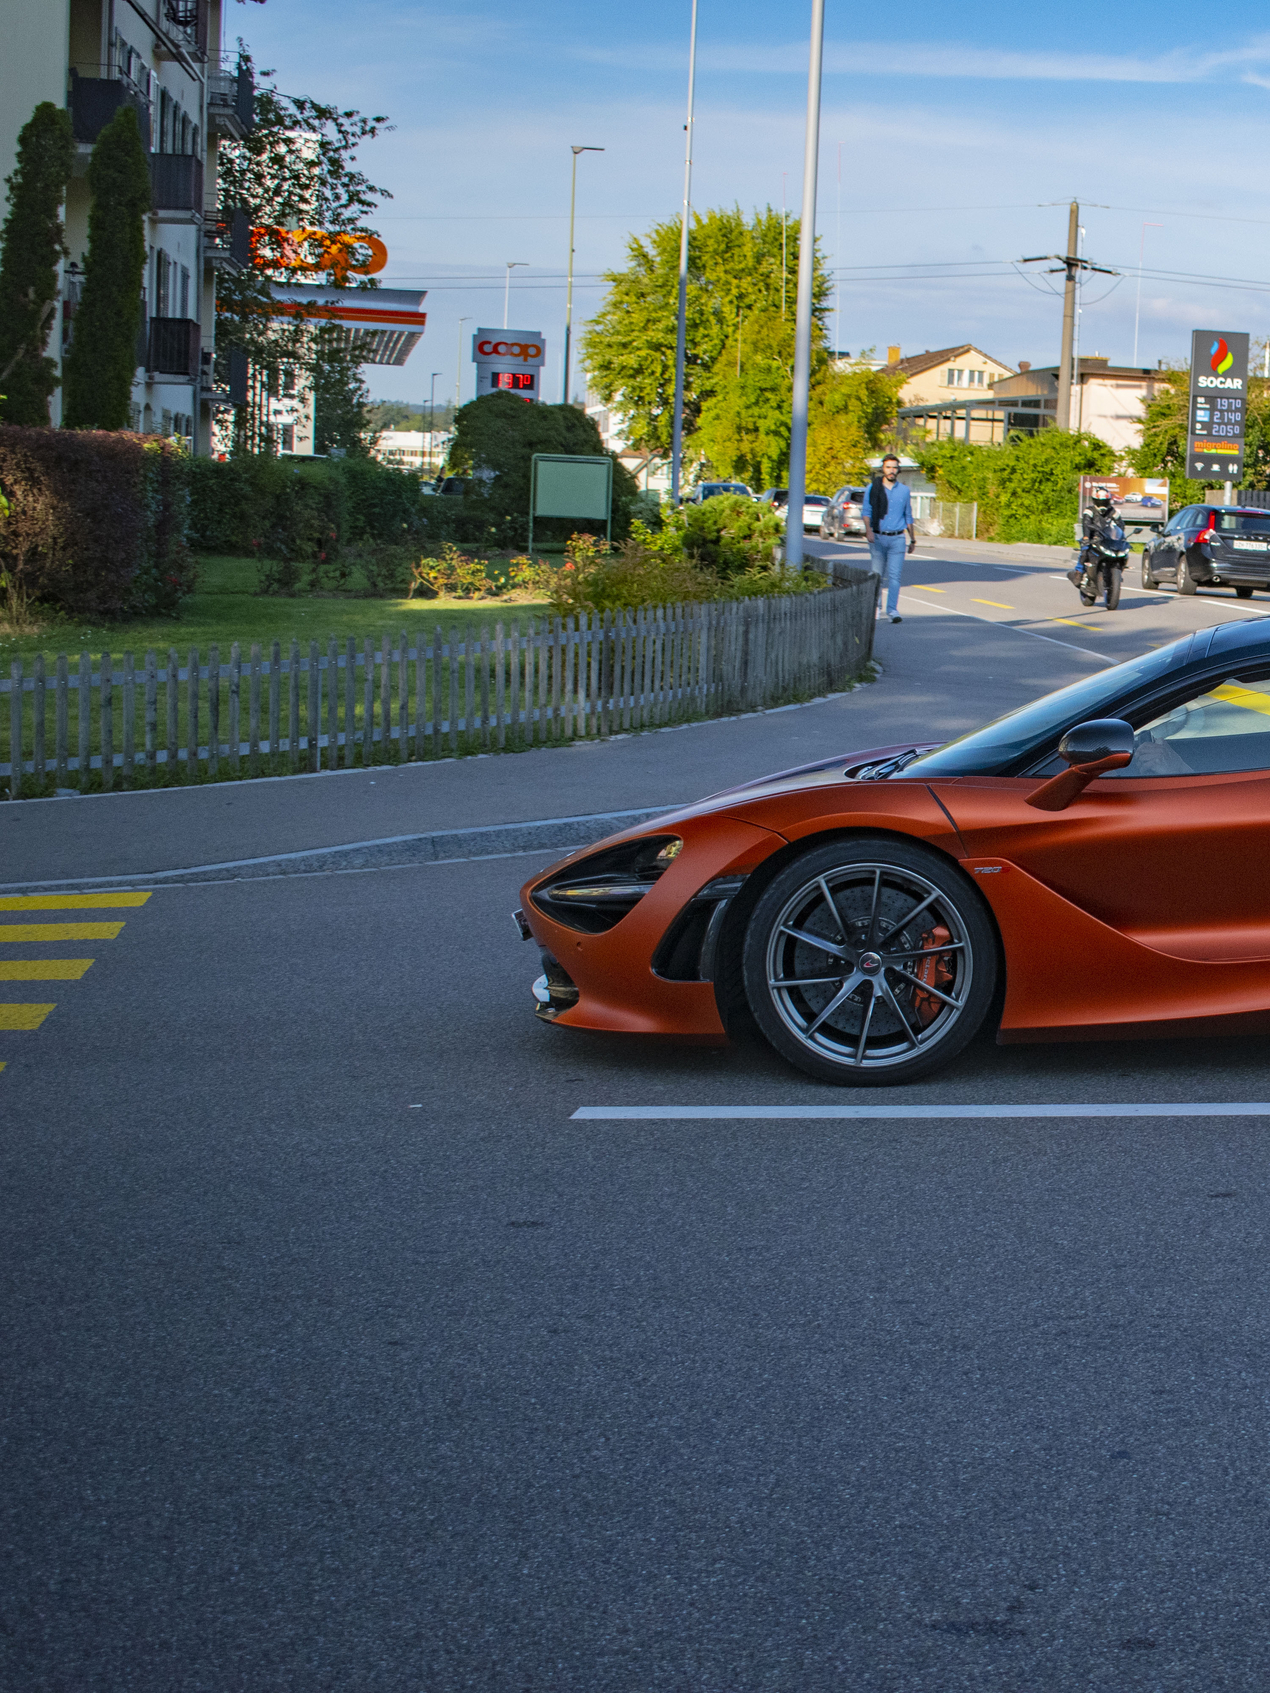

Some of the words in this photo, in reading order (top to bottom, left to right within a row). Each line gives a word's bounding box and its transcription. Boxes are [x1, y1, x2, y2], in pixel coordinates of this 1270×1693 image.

[477, 340, 542, 362] coop
[1198, 376, 1243, 390] SOCAR
[1194, 439, 1240, 451] migrolino
